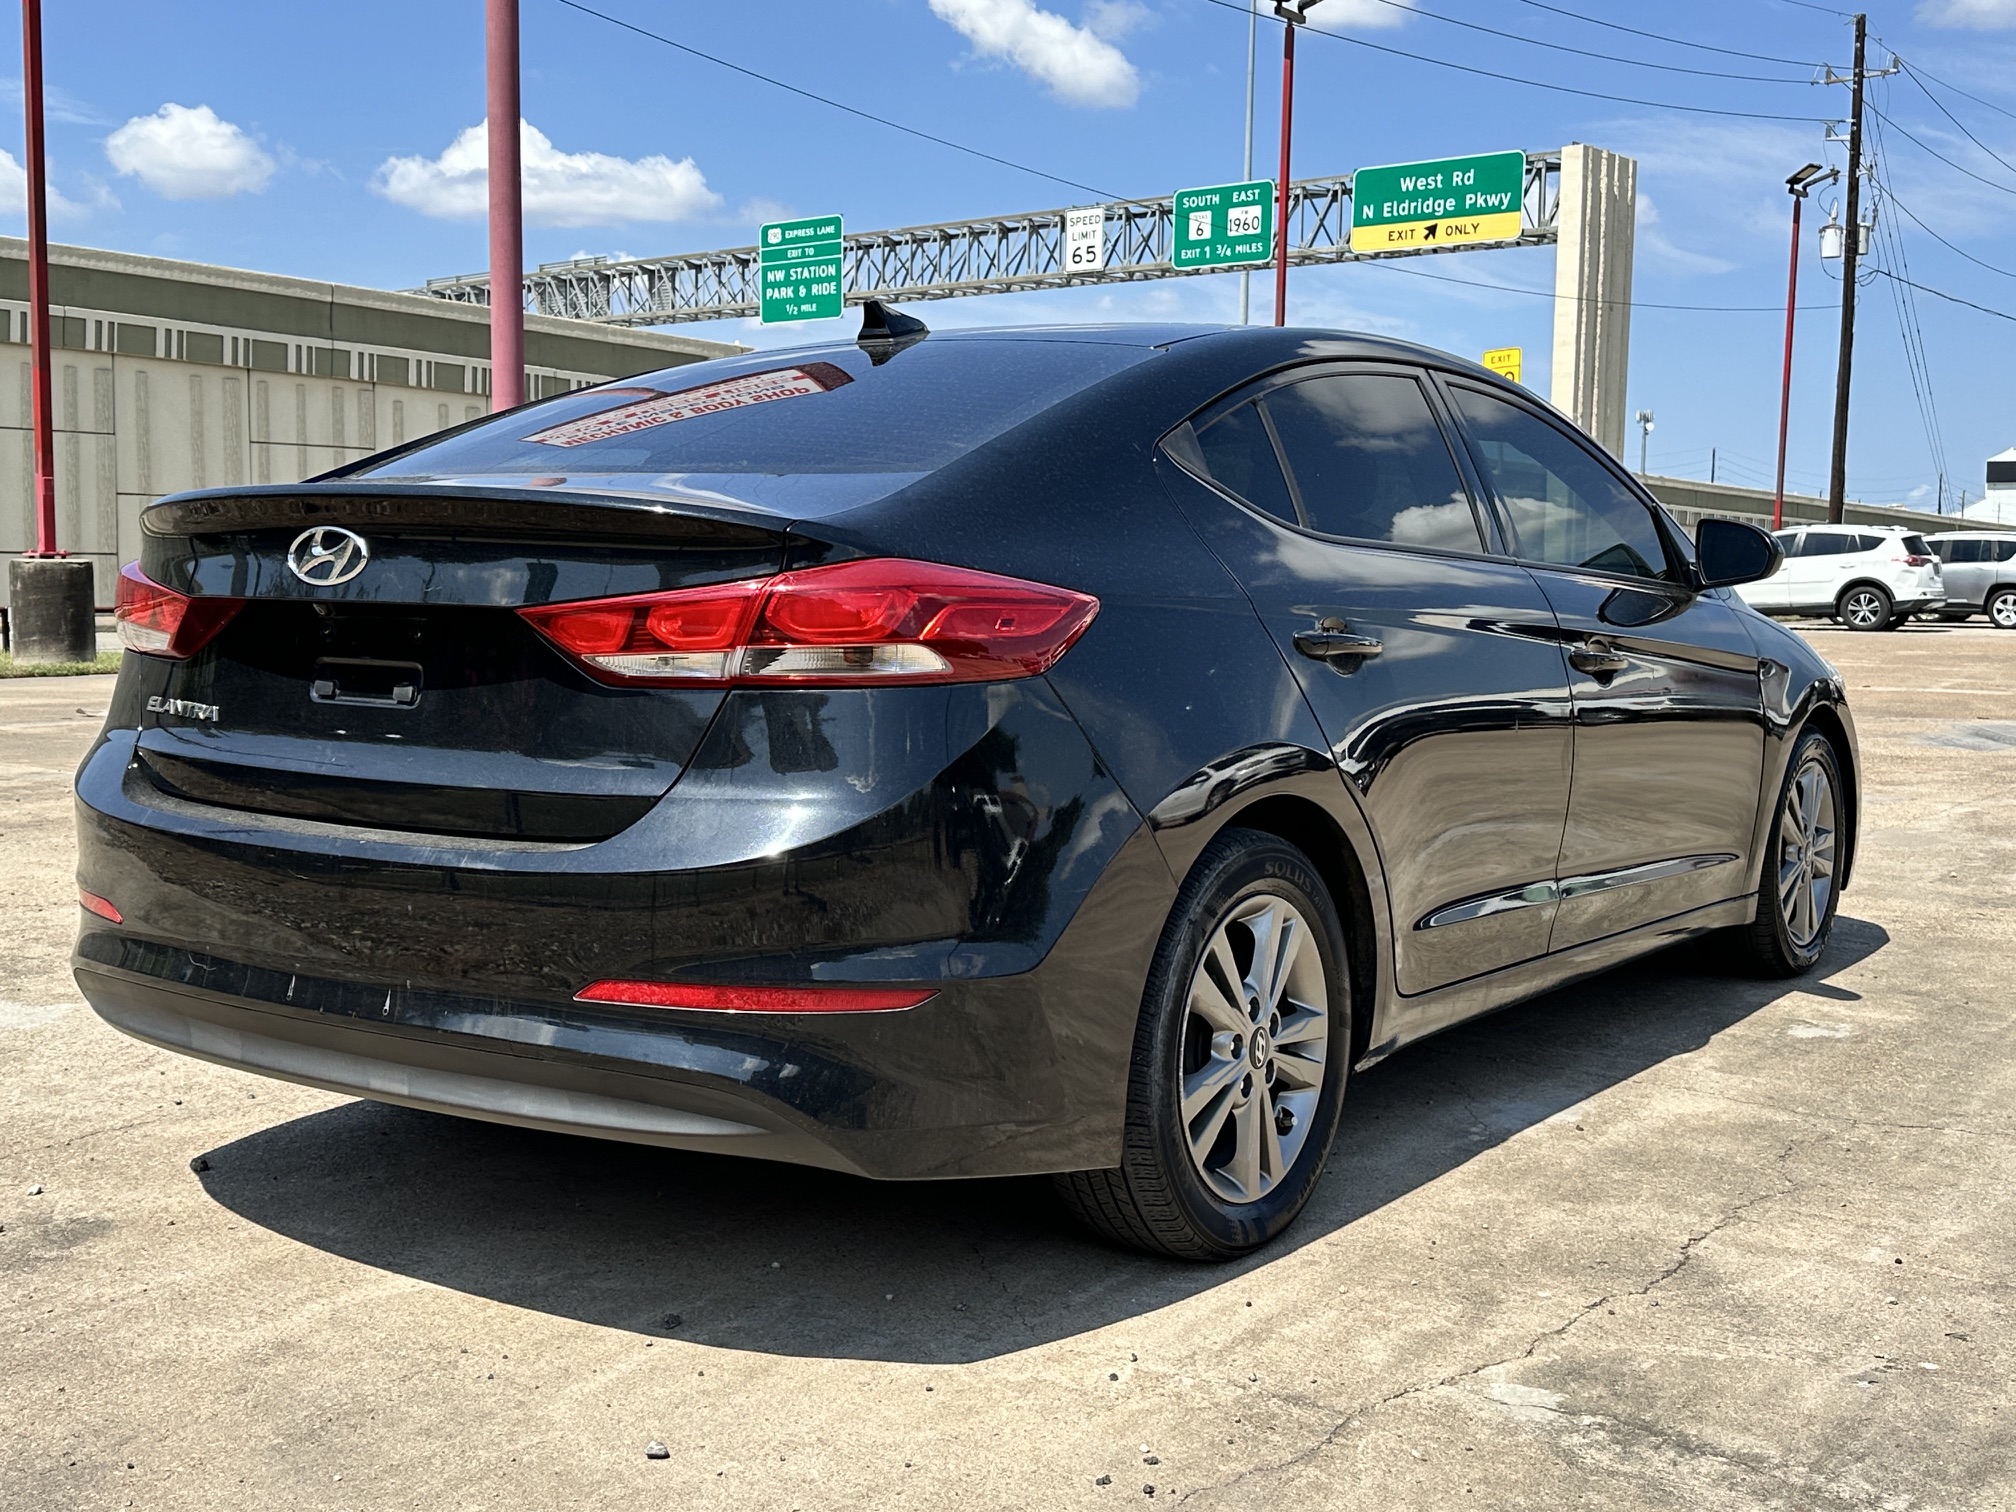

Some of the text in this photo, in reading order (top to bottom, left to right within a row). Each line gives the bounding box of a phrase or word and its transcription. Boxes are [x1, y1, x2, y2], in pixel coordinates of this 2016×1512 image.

[1400, 168, 1475, 191] West Rd
[1183, 189, 1260, 208] SOUTH EAST
[1362, 192, 1511, 219] N Eldridge Pkwy
[1070, 214, 1101, 227] SPEED
[1196, 222, 1204, 236] 6
[1229, 216, 1260, 233] 1960
[785, 227, 814, 239] EXPRESS
[817, 225, 835, 235] LANE
[1072, 230, 1097, 242] LIMIT
[1388, 223, 1480, 242] EXIT ONLY
[787, 247, 814, 258] EXIT TO
[1072, 245, 1096, 264] 65
[1181, 242, 1263, 259] EXIT 1 3/4 MILES
[767, 264, 836, 282] NW STATION
[766, 282, 837, 300] PARK & RIDE
[786, 303, 817, 315] 1/2 MILE
[1491, 354, 1511, 364] EXIT
[146, 696, 219, 721] ELANTRA
[1264, 861, 1313, 892] SOLUS
